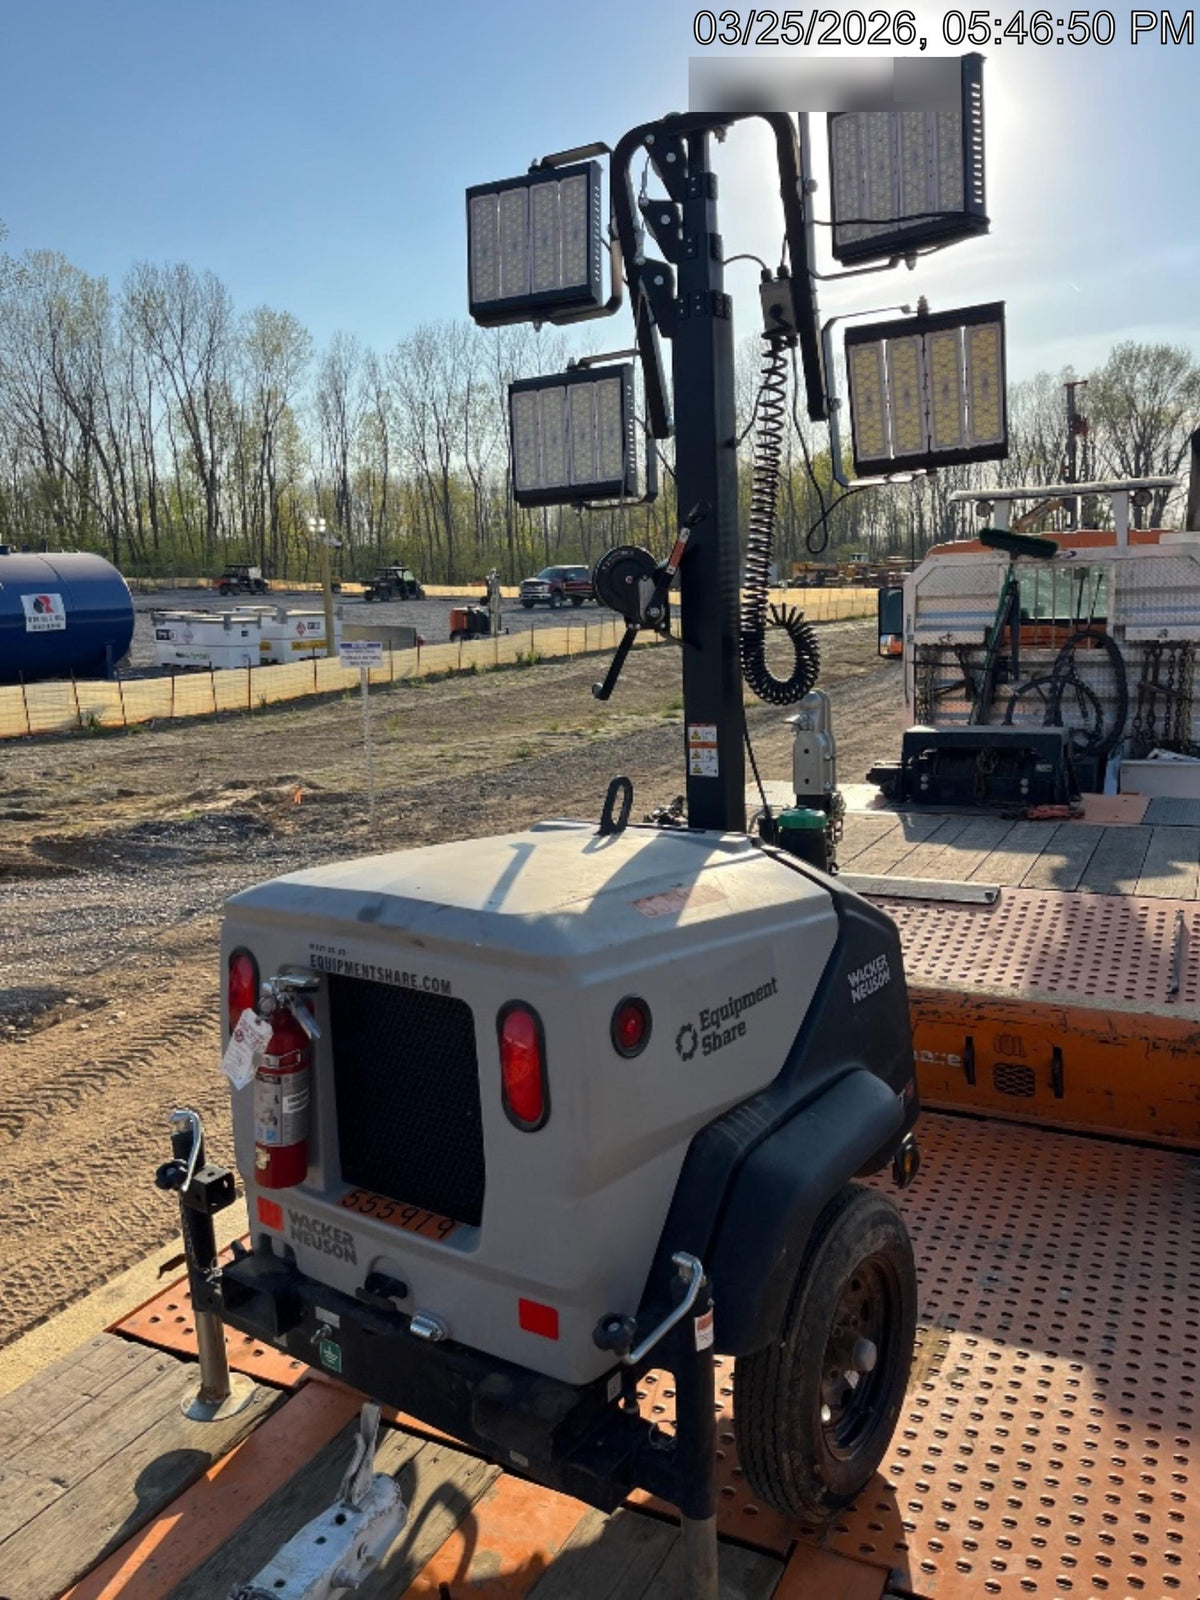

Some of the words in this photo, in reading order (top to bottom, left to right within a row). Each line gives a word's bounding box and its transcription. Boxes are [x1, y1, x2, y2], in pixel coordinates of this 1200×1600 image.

[310, 954, 452, 995] EQUIPMENTSHARE.COM
[847, 954, 888, 987] WACKER
[851, 967, 891, 1004] NEUSON
[699, 976, 778, 1032] Equipment
[702, 1021, 747, 1057] Share
[287, 1208, 354, 1248] WACKER
[342, 1189, 456, 1240] 555919
[290, 1225, 358, 1266] NEUSON
